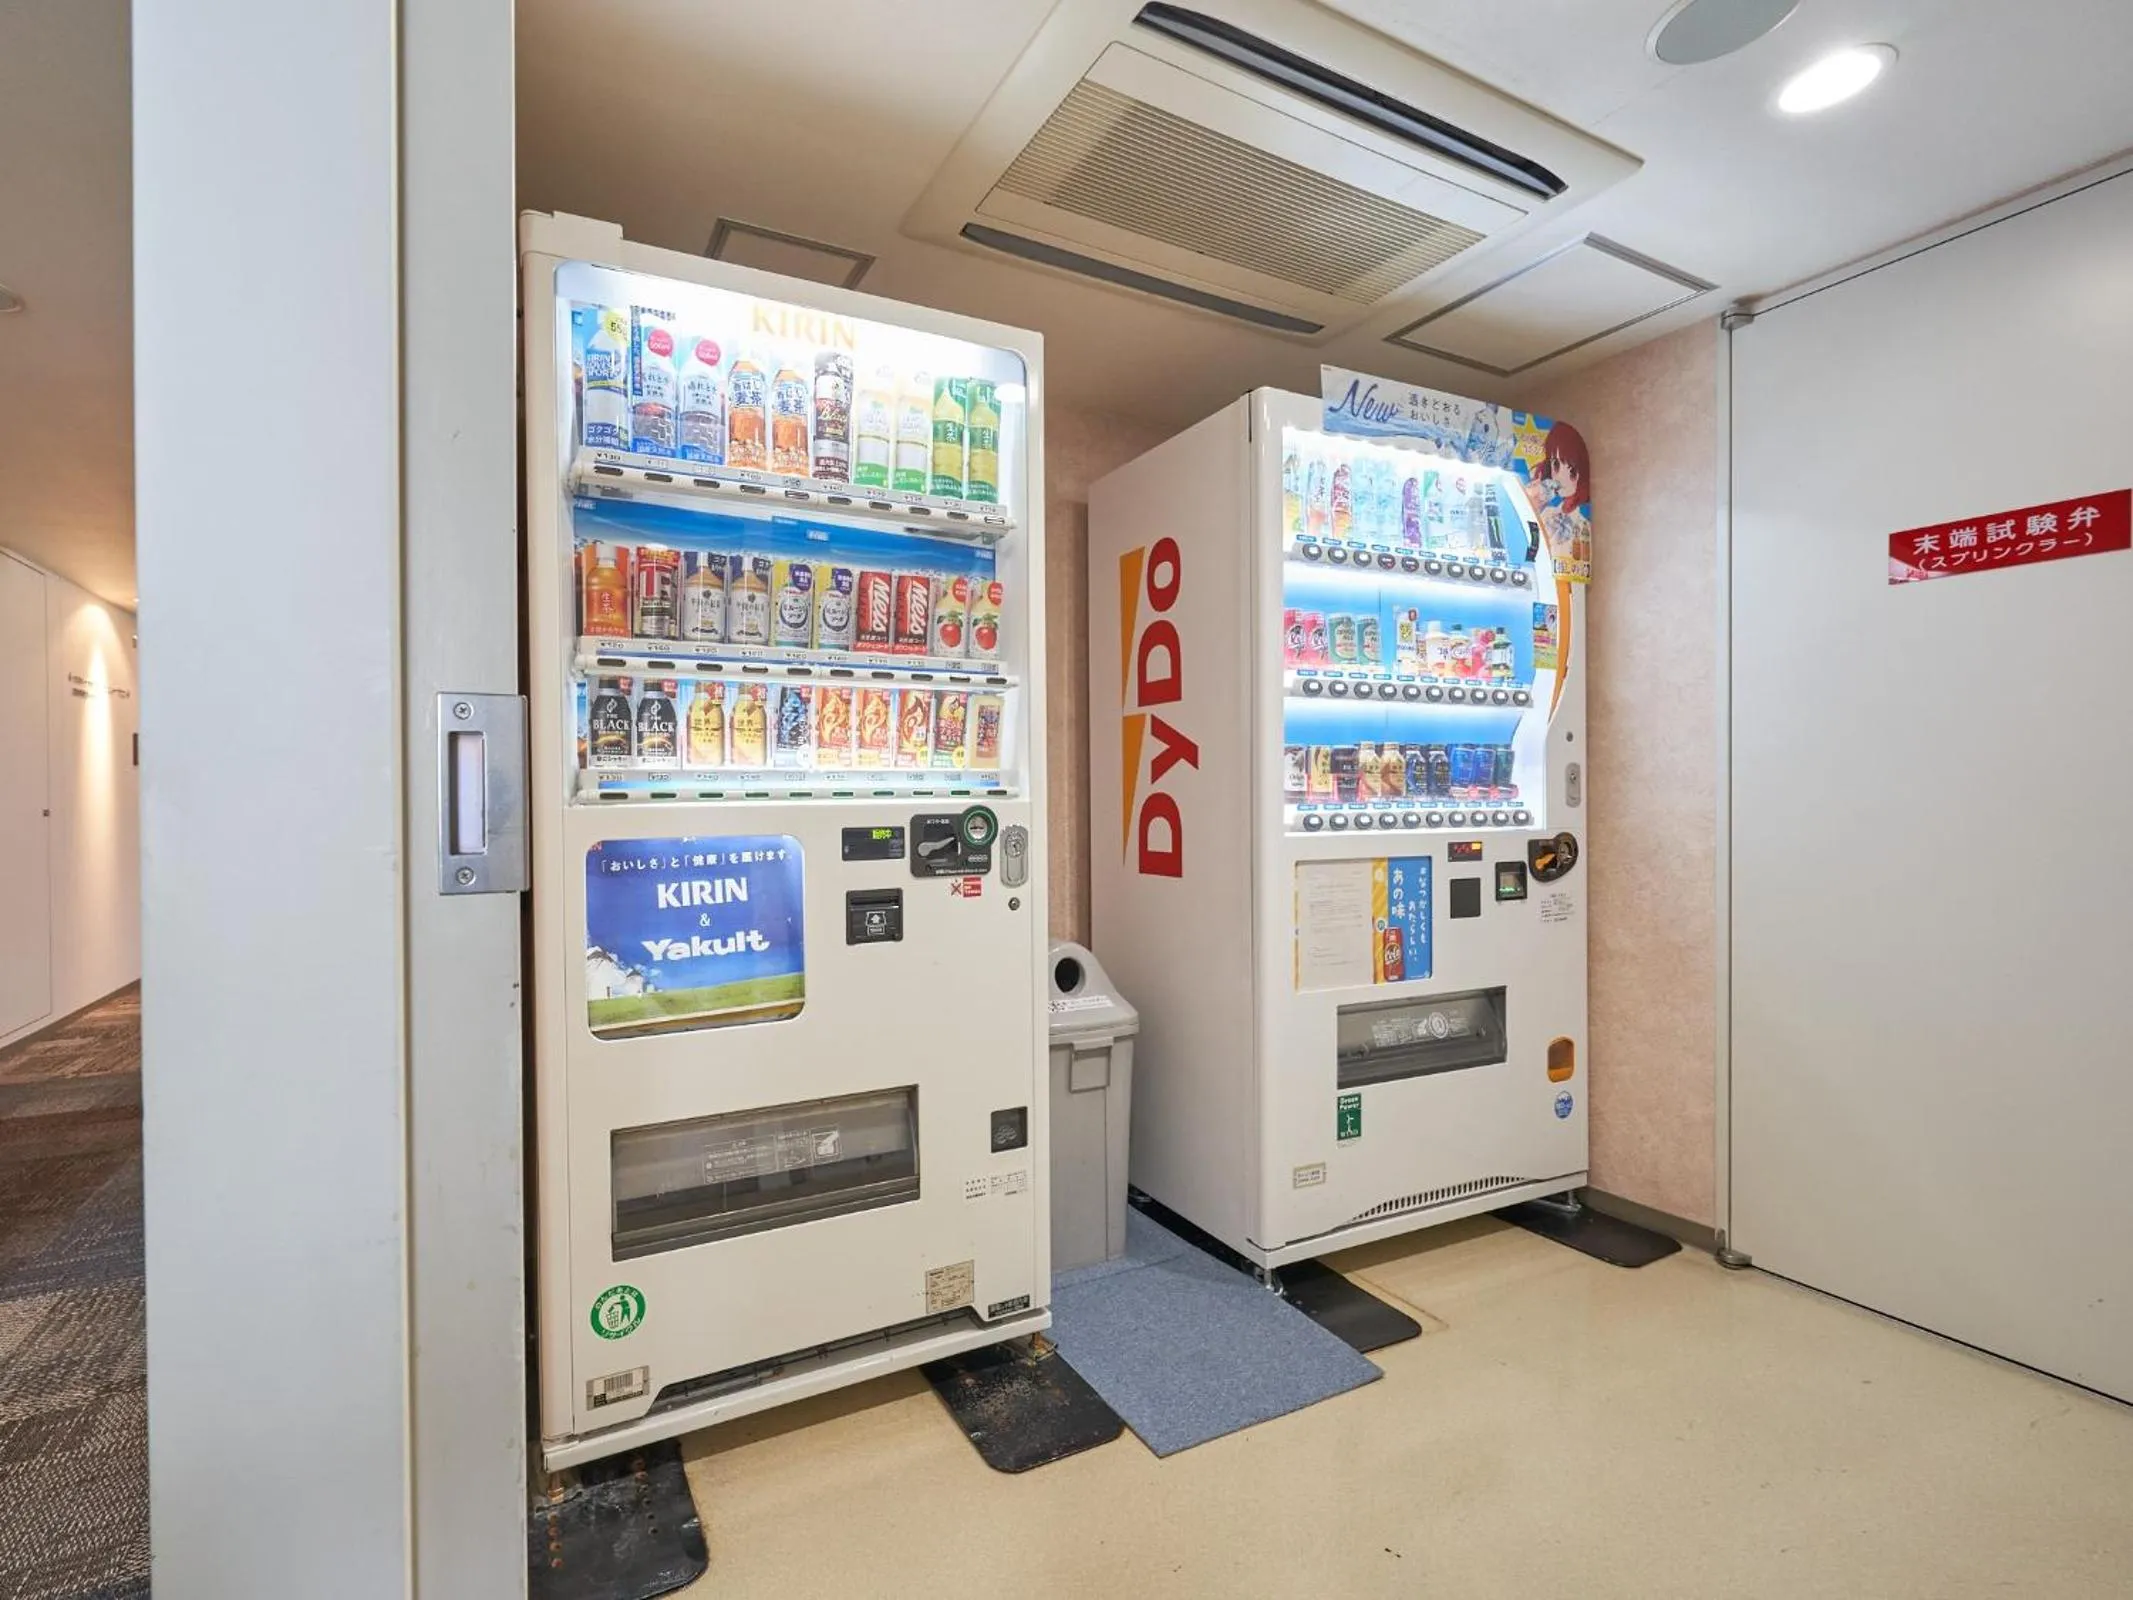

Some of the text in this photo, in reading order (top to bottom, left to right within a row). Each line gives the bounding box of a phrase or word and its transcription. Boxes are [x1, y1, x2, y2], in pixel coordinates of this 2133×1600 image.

[751, 299, 857, 351] KIRIN
[1328, 379, 1400, 424] New
[1410, 409, 1451, 427] おいしさ
[1913, 506, 2101, 555] 末端試験弁
[872, 577, 890, 632] Mets
[910, 580, 928, 634] Mets
[593, 719, 630, 731] BLACK
[638, 722, 675, 732] BLACK
[656, 877, 749, 909] KIRIN
[1391, 868, 1406, 920] あの味
[699, 913, 711, 927] &
[641, 929, 771, 962] Yakult
